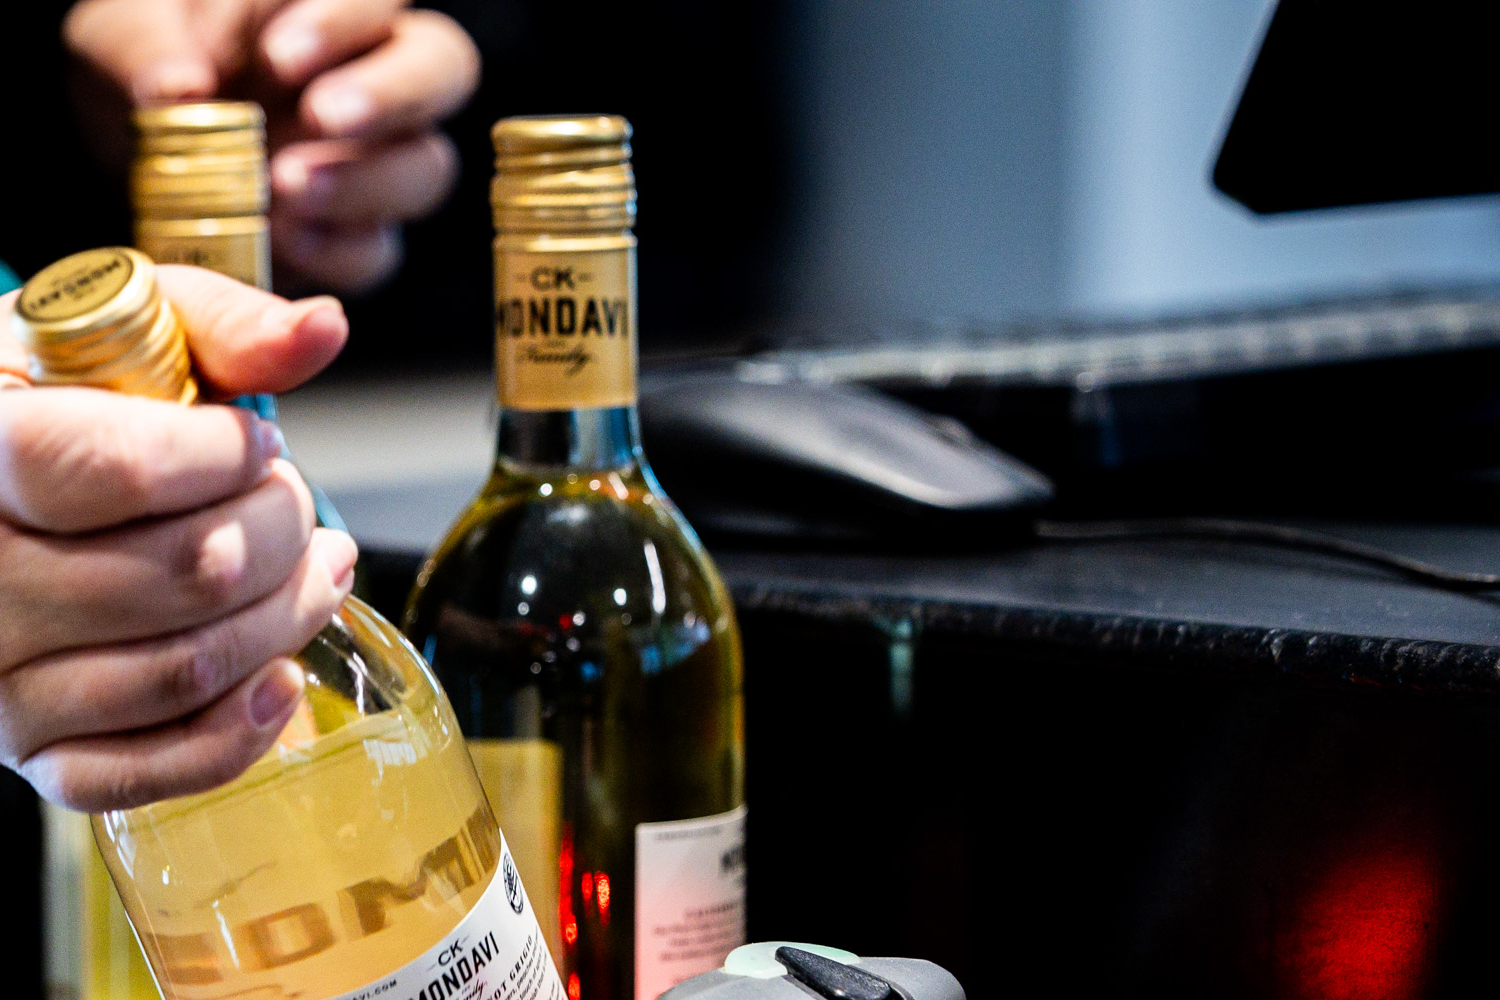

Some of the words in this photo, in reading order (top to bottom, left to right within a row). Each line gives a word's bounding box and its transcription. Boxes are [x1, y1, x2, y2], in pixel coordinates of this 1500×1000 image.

[530, 266, 575, 291] CK
[438, 938, 463, 966] CK
[509, 934, 532, 981] GRIGIO
[520, 979, 533, 1000] touch
